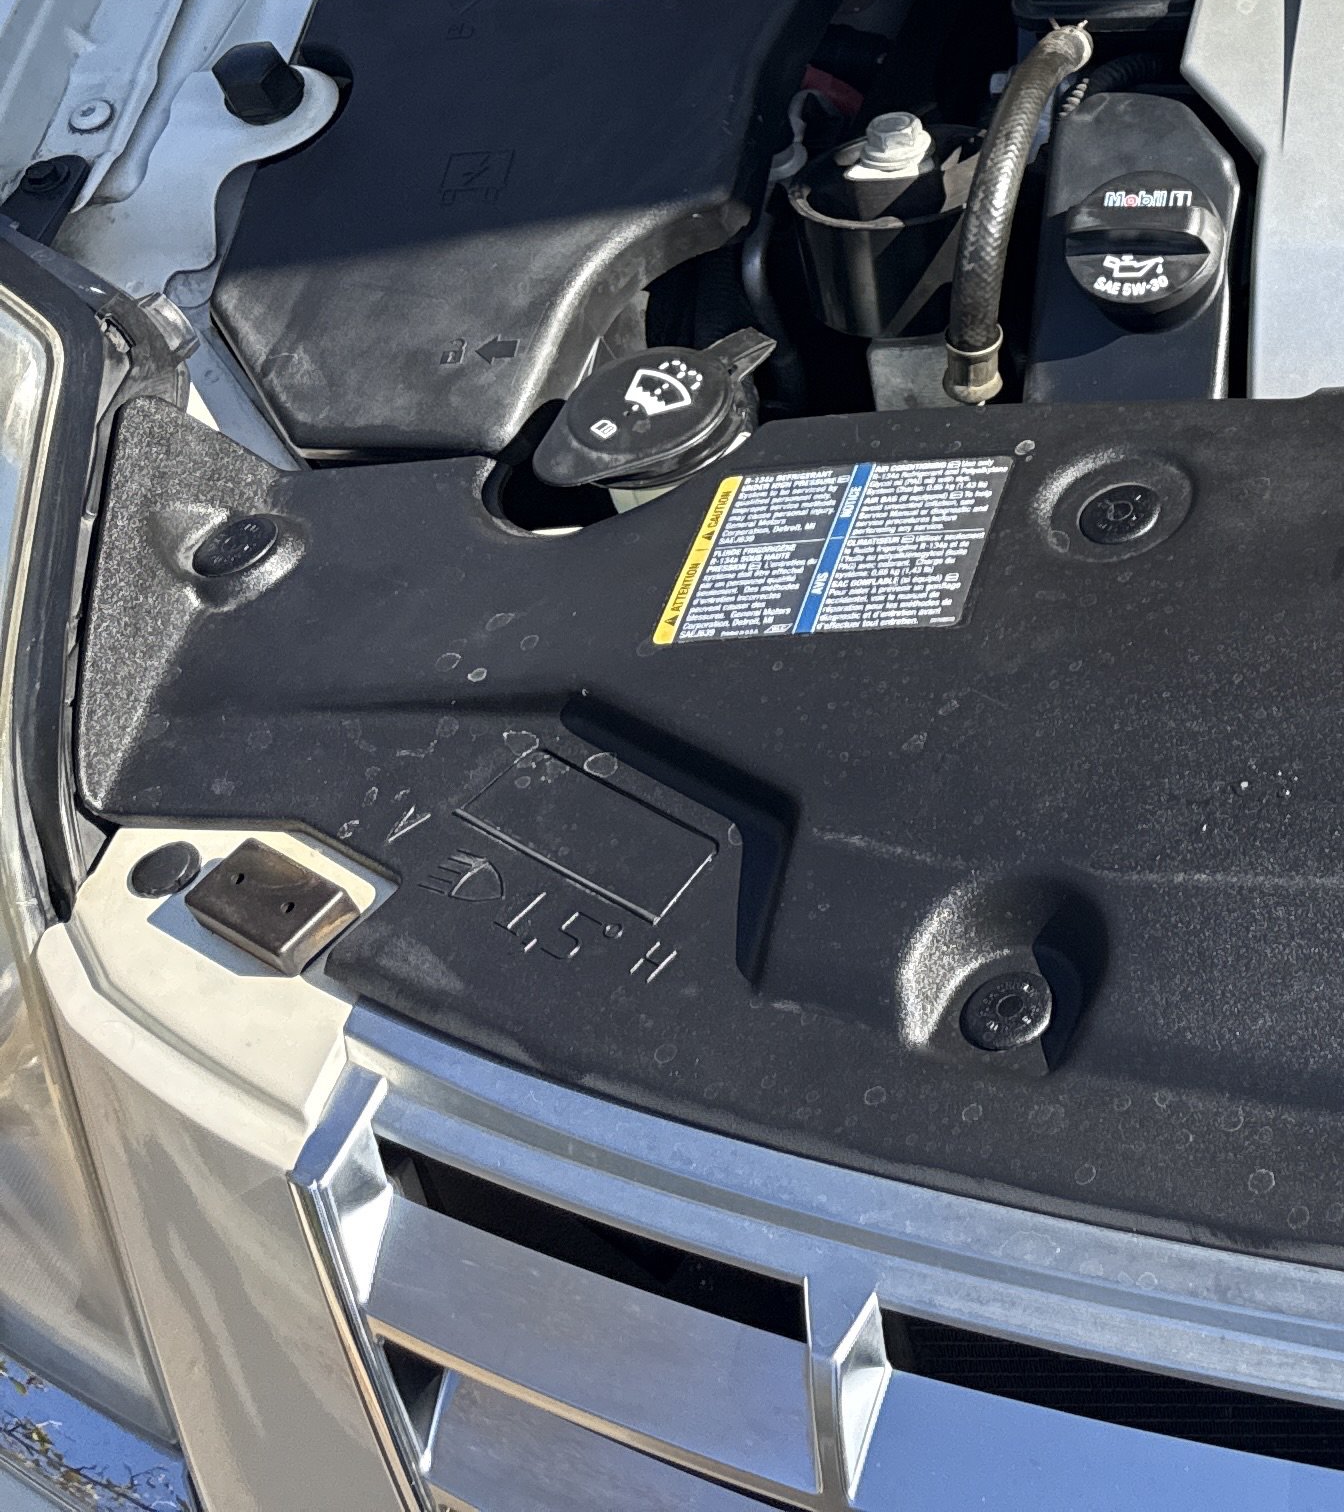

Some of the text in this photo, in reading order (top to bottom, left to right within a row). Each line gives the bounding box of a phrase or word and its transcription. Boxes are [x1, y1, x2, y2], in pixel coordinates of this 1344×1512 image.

[1103, 190, 1167, 208] Mobil
[1093, 274, 1169, 297] SAE 5W-30
[708, 491, 732, 529] CAUTION
[840, 486, 863, 518] NOTICE
[671, 563, 701, 612] ATTENTION
[811, 572, 829, 595] AVIS
[629, 941, 678, 983] H
